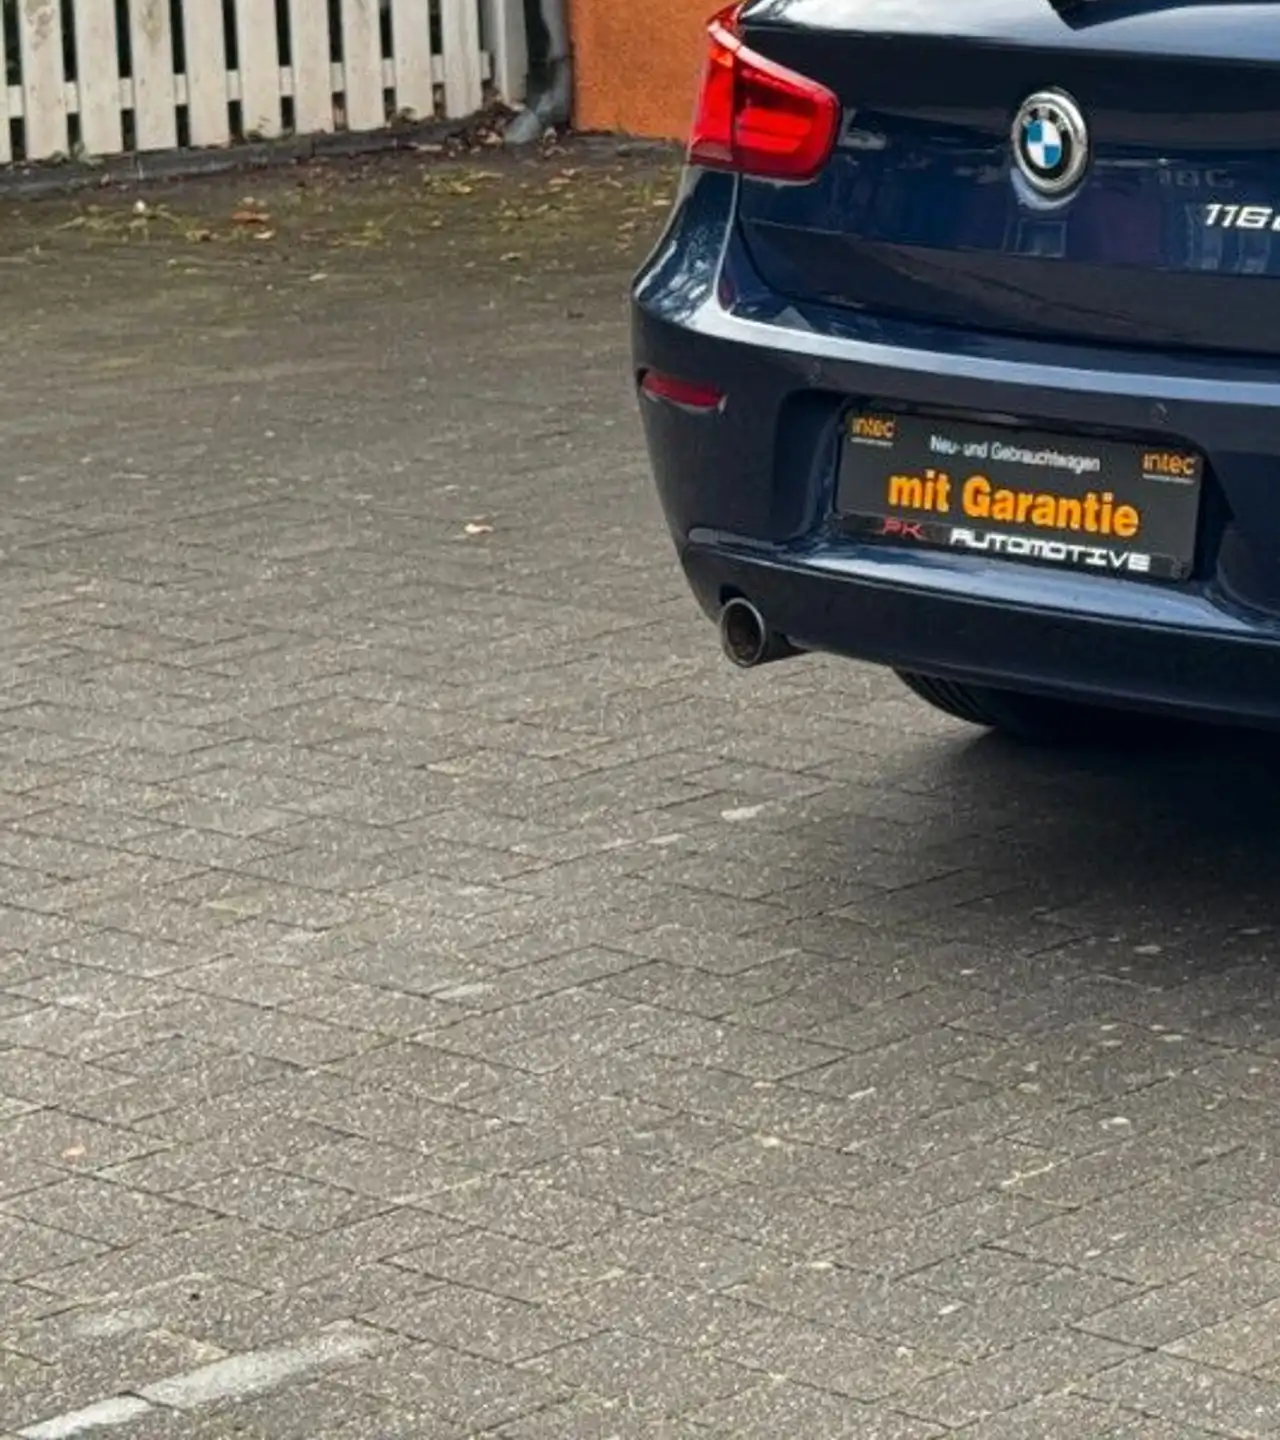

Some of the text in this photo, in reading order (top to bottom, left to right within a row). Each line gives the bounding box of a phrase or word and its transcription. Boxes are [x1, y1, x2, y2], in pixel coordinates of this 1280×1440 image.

[852, 416, 895, 439] intec
[930, 434, 1101, 475] Neu- und Gebrauchtwagen
[1143, 451, 1195, 476] intec
[888, 470, 1141, 538] mit Garantie
[882, 515, 1151, 573] PK AUTOMOTIVE
